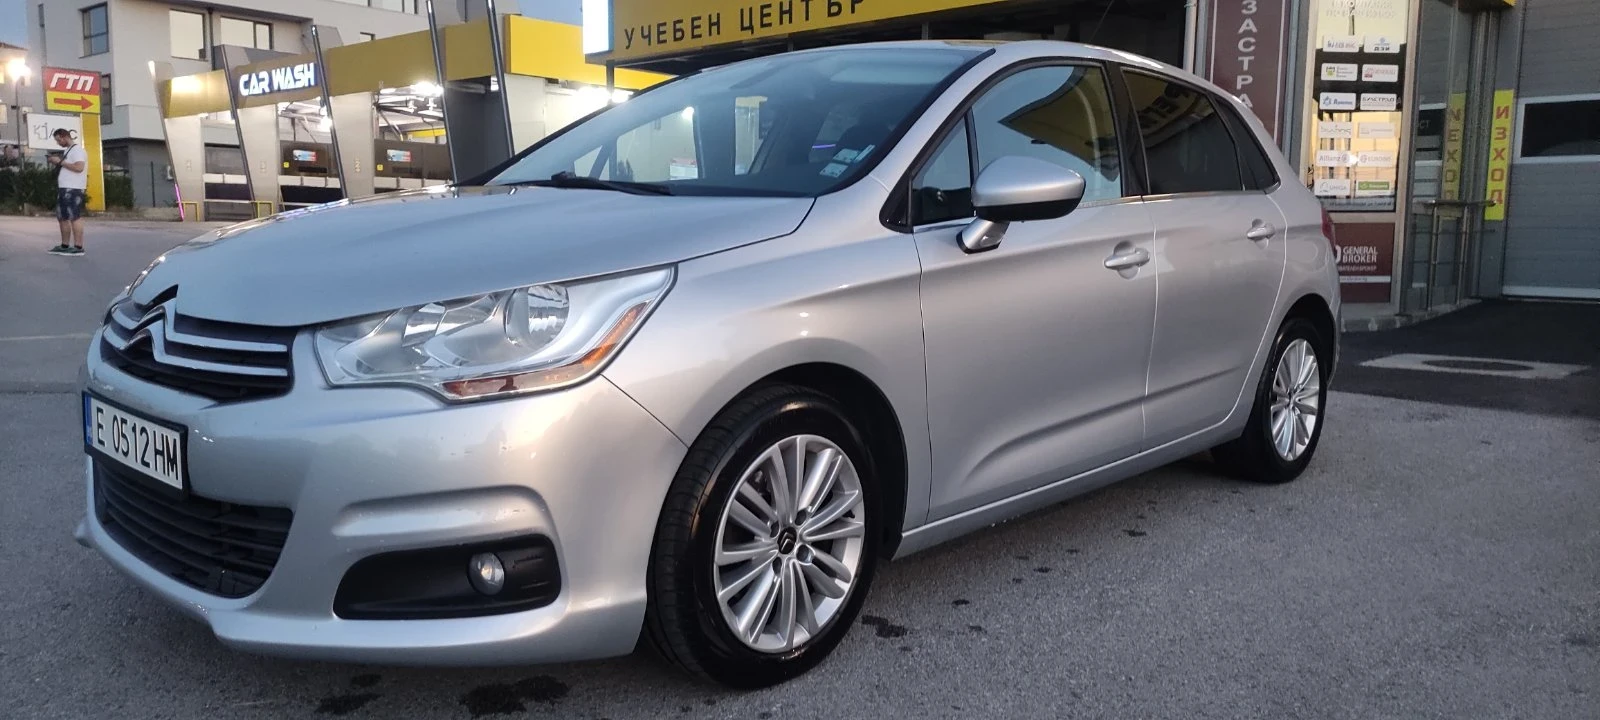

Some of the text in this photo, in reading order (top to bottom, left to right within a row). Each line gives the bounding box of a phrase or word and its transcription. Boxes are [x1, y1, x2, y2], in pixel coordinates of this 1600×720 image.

[624, 12, 721, 49] УЧЕБЕН
[50, 72, 94, 92] ГТП
[239, 62, 315, 96] CAR WASH
[1490, 105, 1510, 205] ИЗХОД
[1342, 246, 1378, 255] GENERAL
[1342, 254, 1377, 264] BROKER
[96, 406, 106, 447] E
